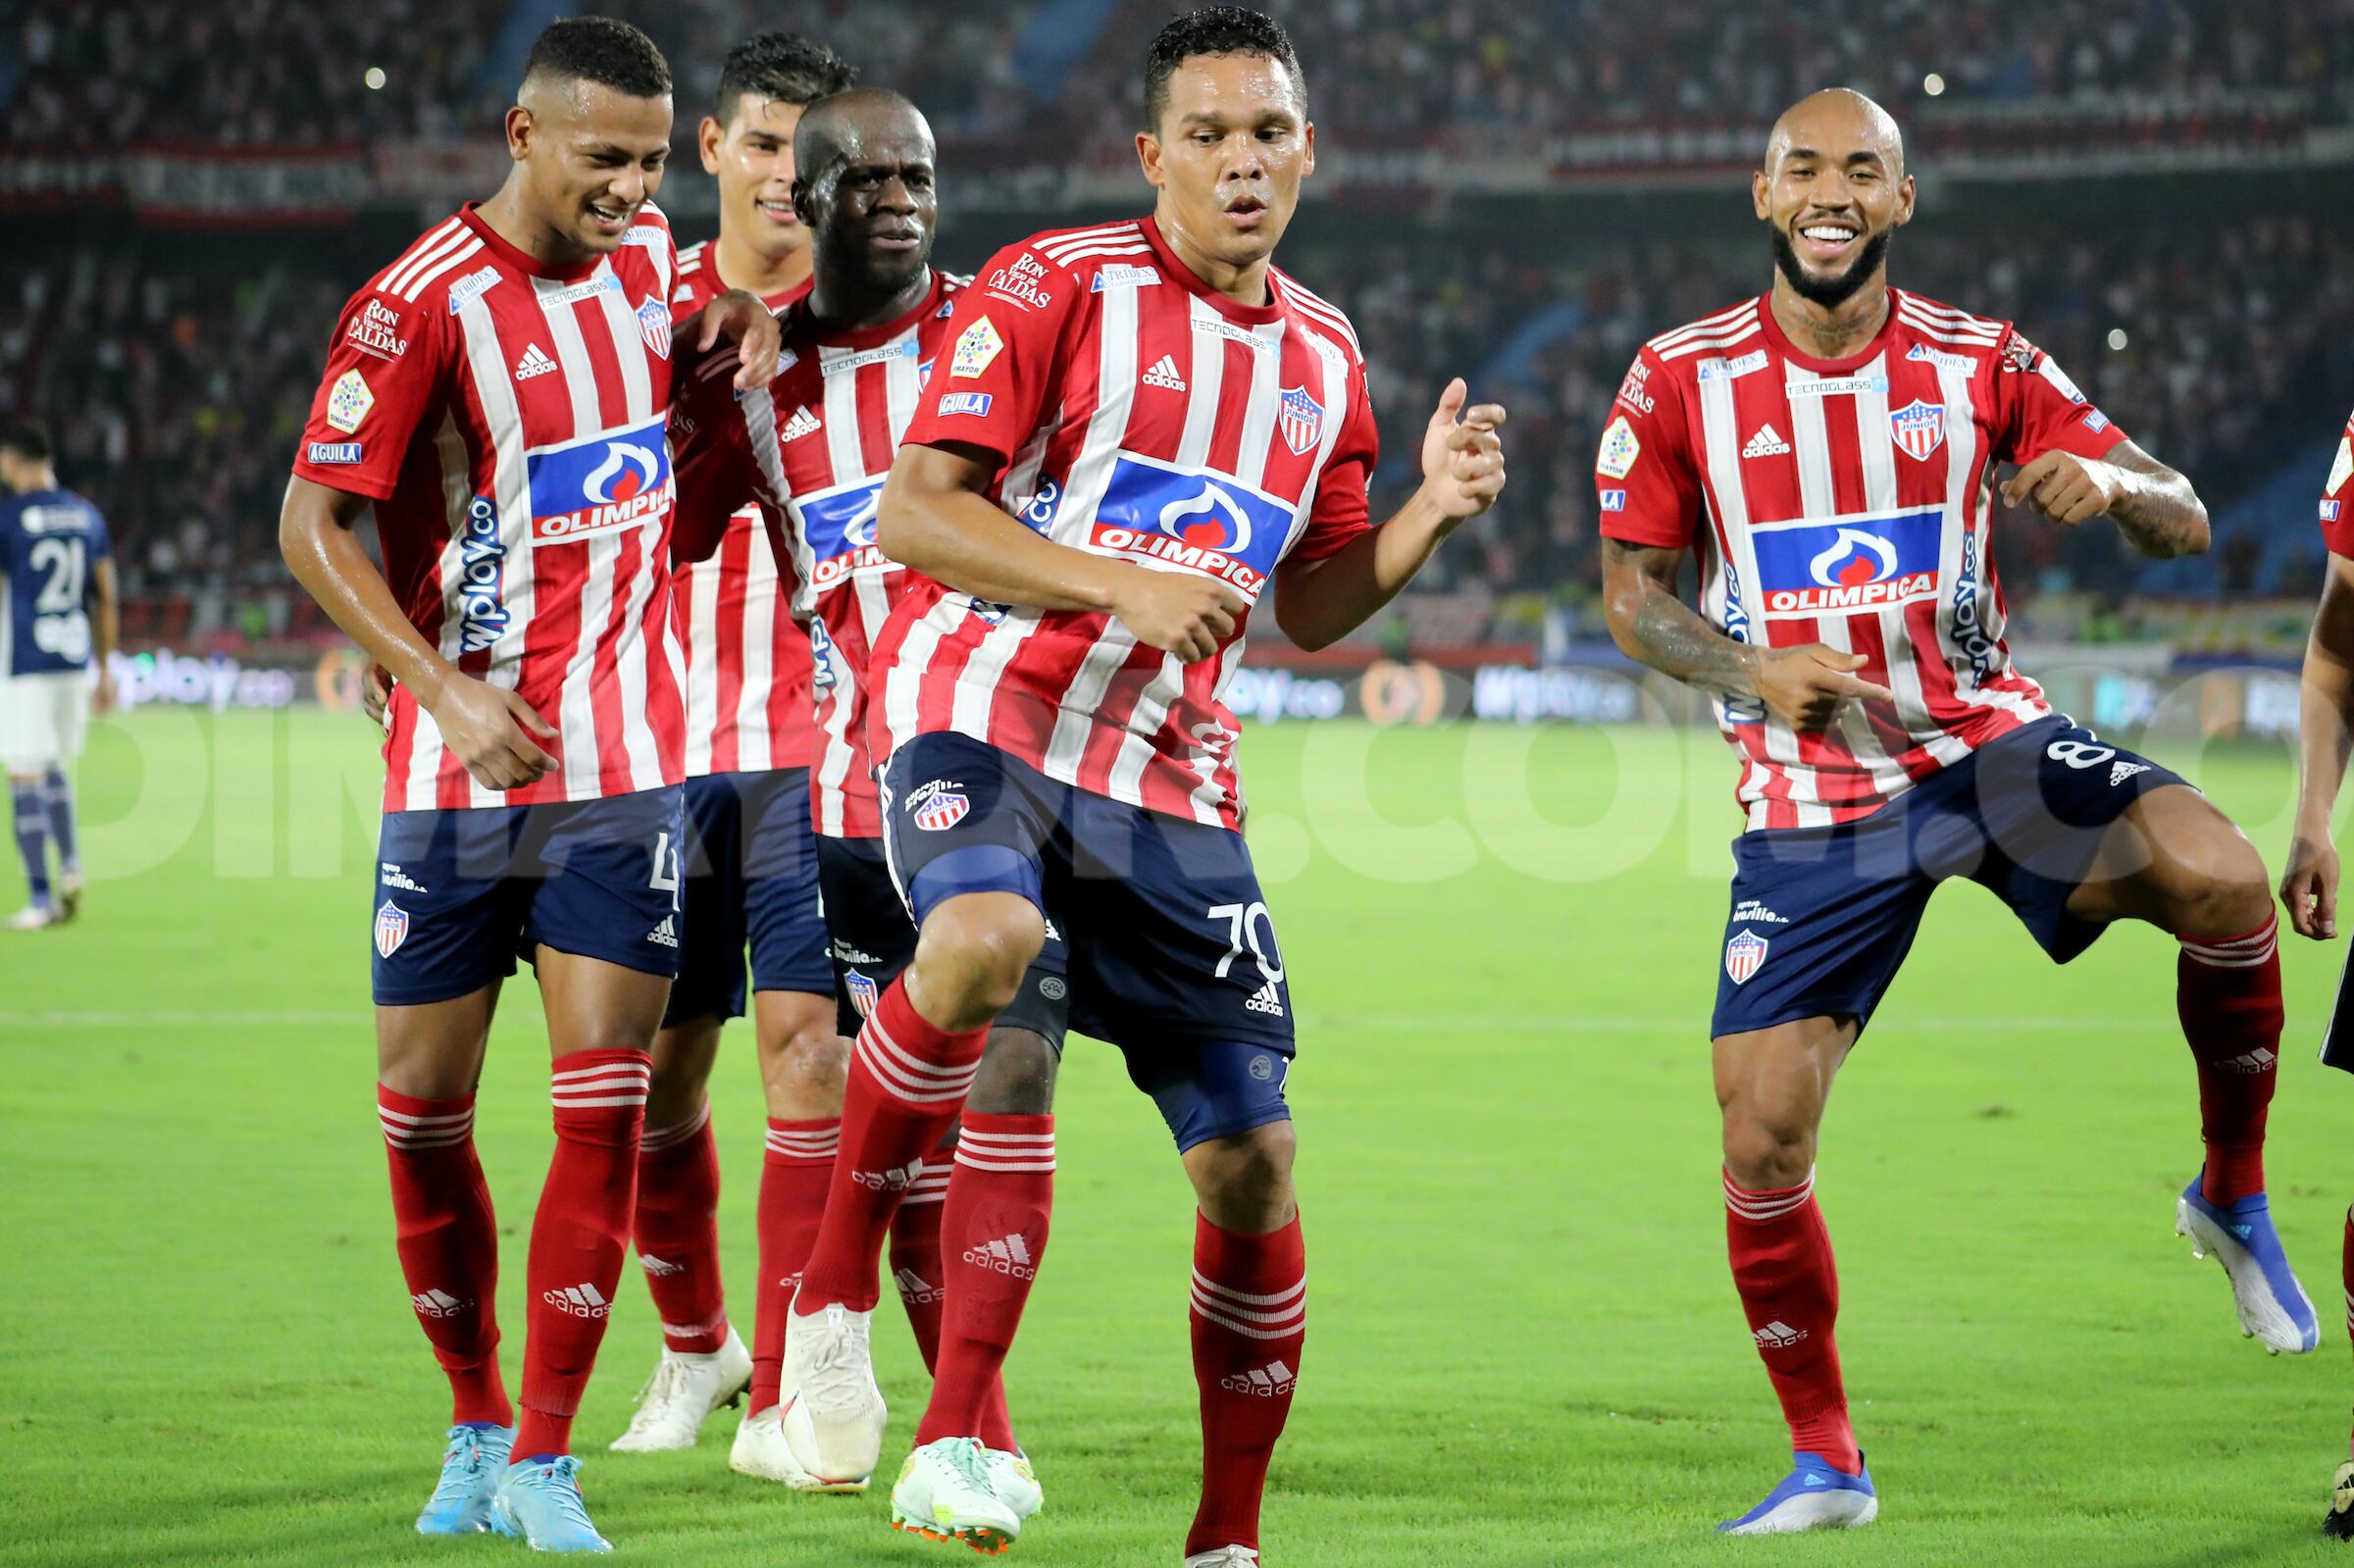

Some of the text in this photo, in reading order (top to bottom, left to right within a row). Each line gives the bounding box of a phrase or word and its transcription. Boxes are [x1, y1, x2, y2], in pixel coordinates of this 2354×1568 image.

[1011, 252, 1049, 278] RON
[988, 269, 1052, 308] CALDAS
[347, 316, 407, 356] CALDAS
[515, 359, 558, 380] adidas
[1142, 372, 1187, 392] adidas
[781, 418, 822, 441] adidas
[1285, 407, 1316, 426] JUNIOR
[1900, 418, 1938, 431] JUNIOR
[1742, 442, 1791, 459] adidas
[1099, 528, 1267, 597] OLIMPICA
[1771, 574, 1932, 611] OLIMPICA
[2047, 740, 2116, 769] 8
[649, 833, 681, 911] 4
[646, 932, 679, 948] adidas
[1207, 901, 1285, 984] 70
[1245, 997, 1284, 1018] adidas
[962, 1250, 1035, 1281] adidas
